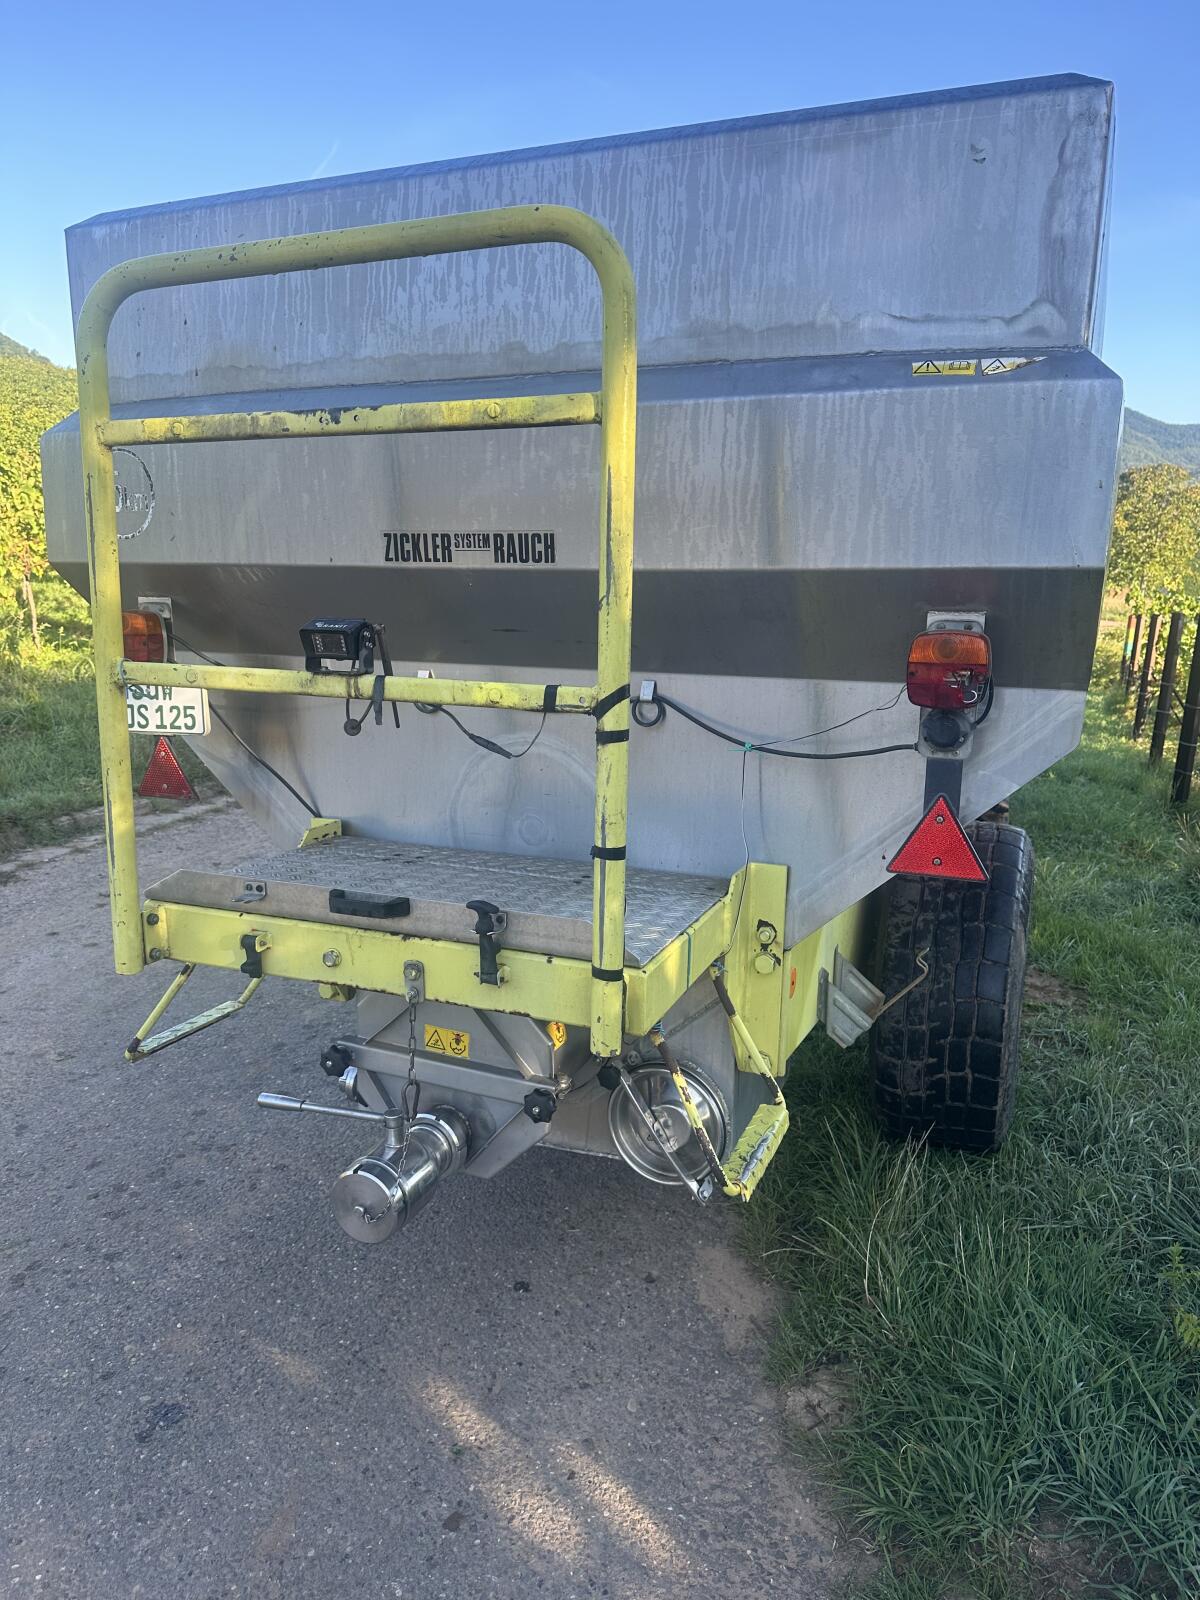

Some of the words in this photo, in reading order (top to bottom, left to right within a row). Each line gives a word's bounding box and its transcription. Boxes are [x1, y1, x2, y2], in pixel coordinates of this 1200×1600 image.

[383, 532, 453, 563] ZICKLER
[454, 533, 491, 549] SYSTEM
[493, 532, 556, 564] RAUCH
[155, 704, 197, 731] 125
